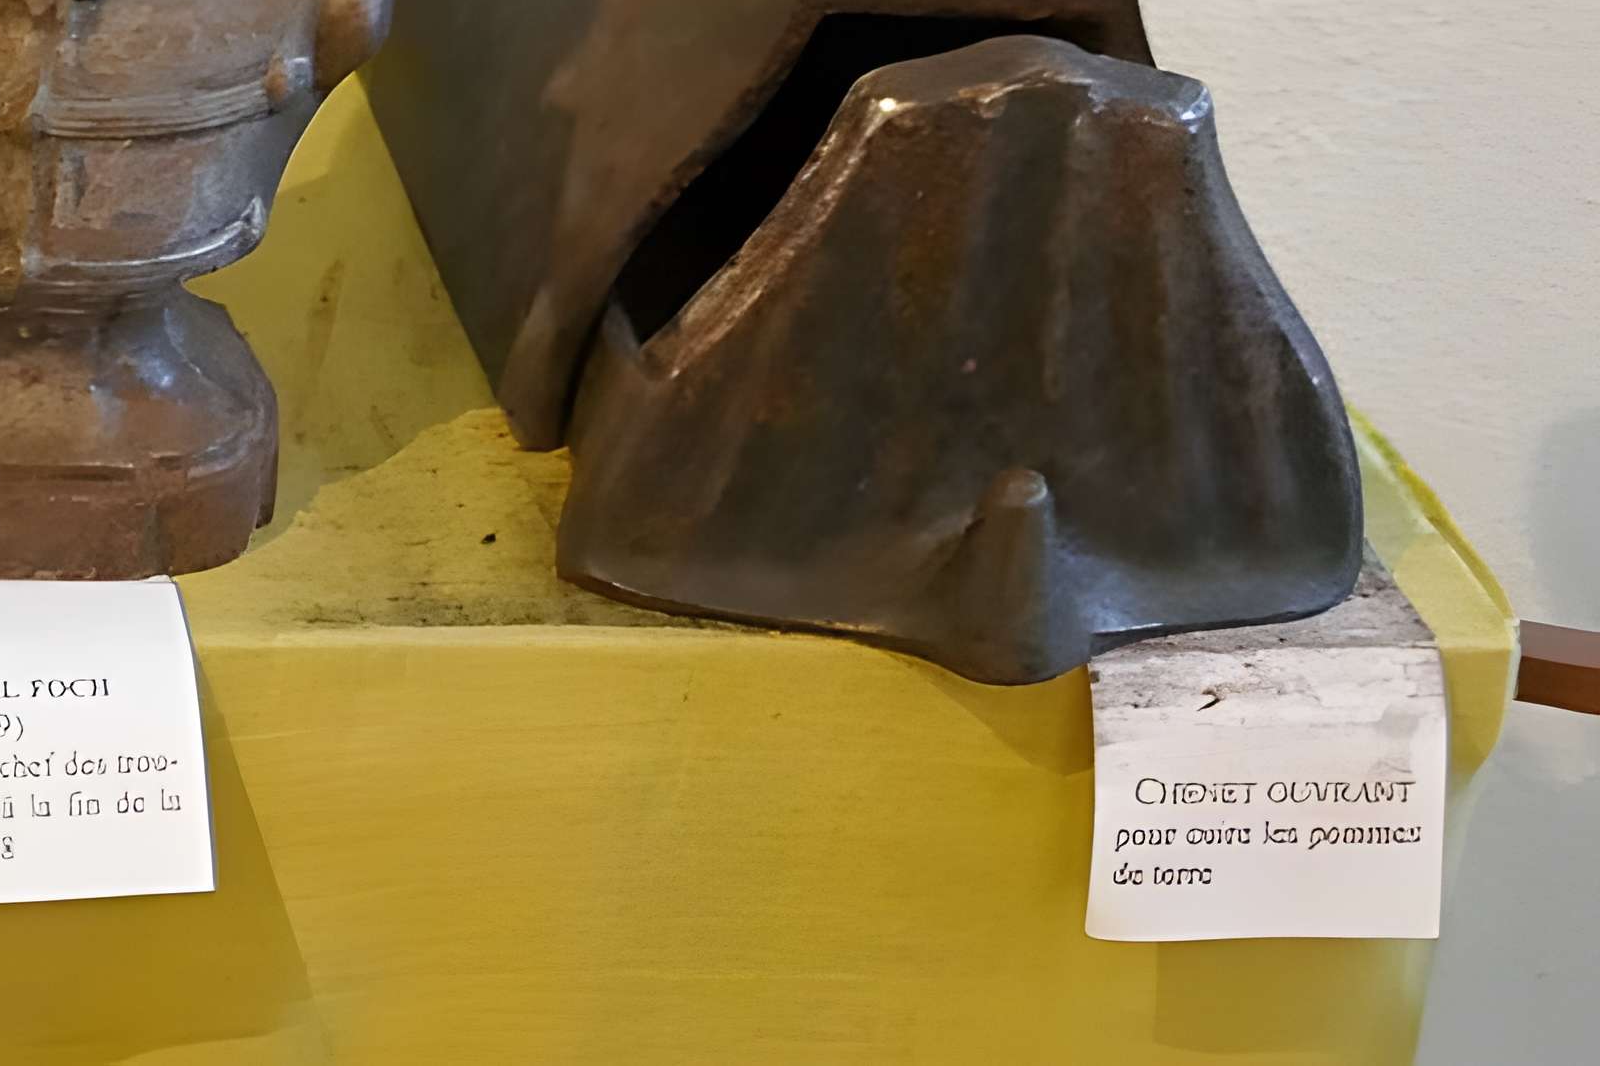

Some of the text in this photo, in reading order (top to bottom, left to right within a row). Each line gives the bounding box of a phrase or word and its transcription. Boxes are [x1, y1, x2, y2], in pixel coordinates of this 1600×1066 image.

[30, 678, 110, 699] FOCH
[64, 749, 108, 777] des
[2, 795, 15, 820] à
[30, 793, 52, 818] la
[68, 790, 101, 817] fin
[116, 790, 145, 815] de
[160, 788, 182, 812] la
[1266, 779, 1415, 804] OUVRANT
[1113, 818, 1421, 851] pour cuire les pommes
[1112, 861, 1213, 885] de terre
